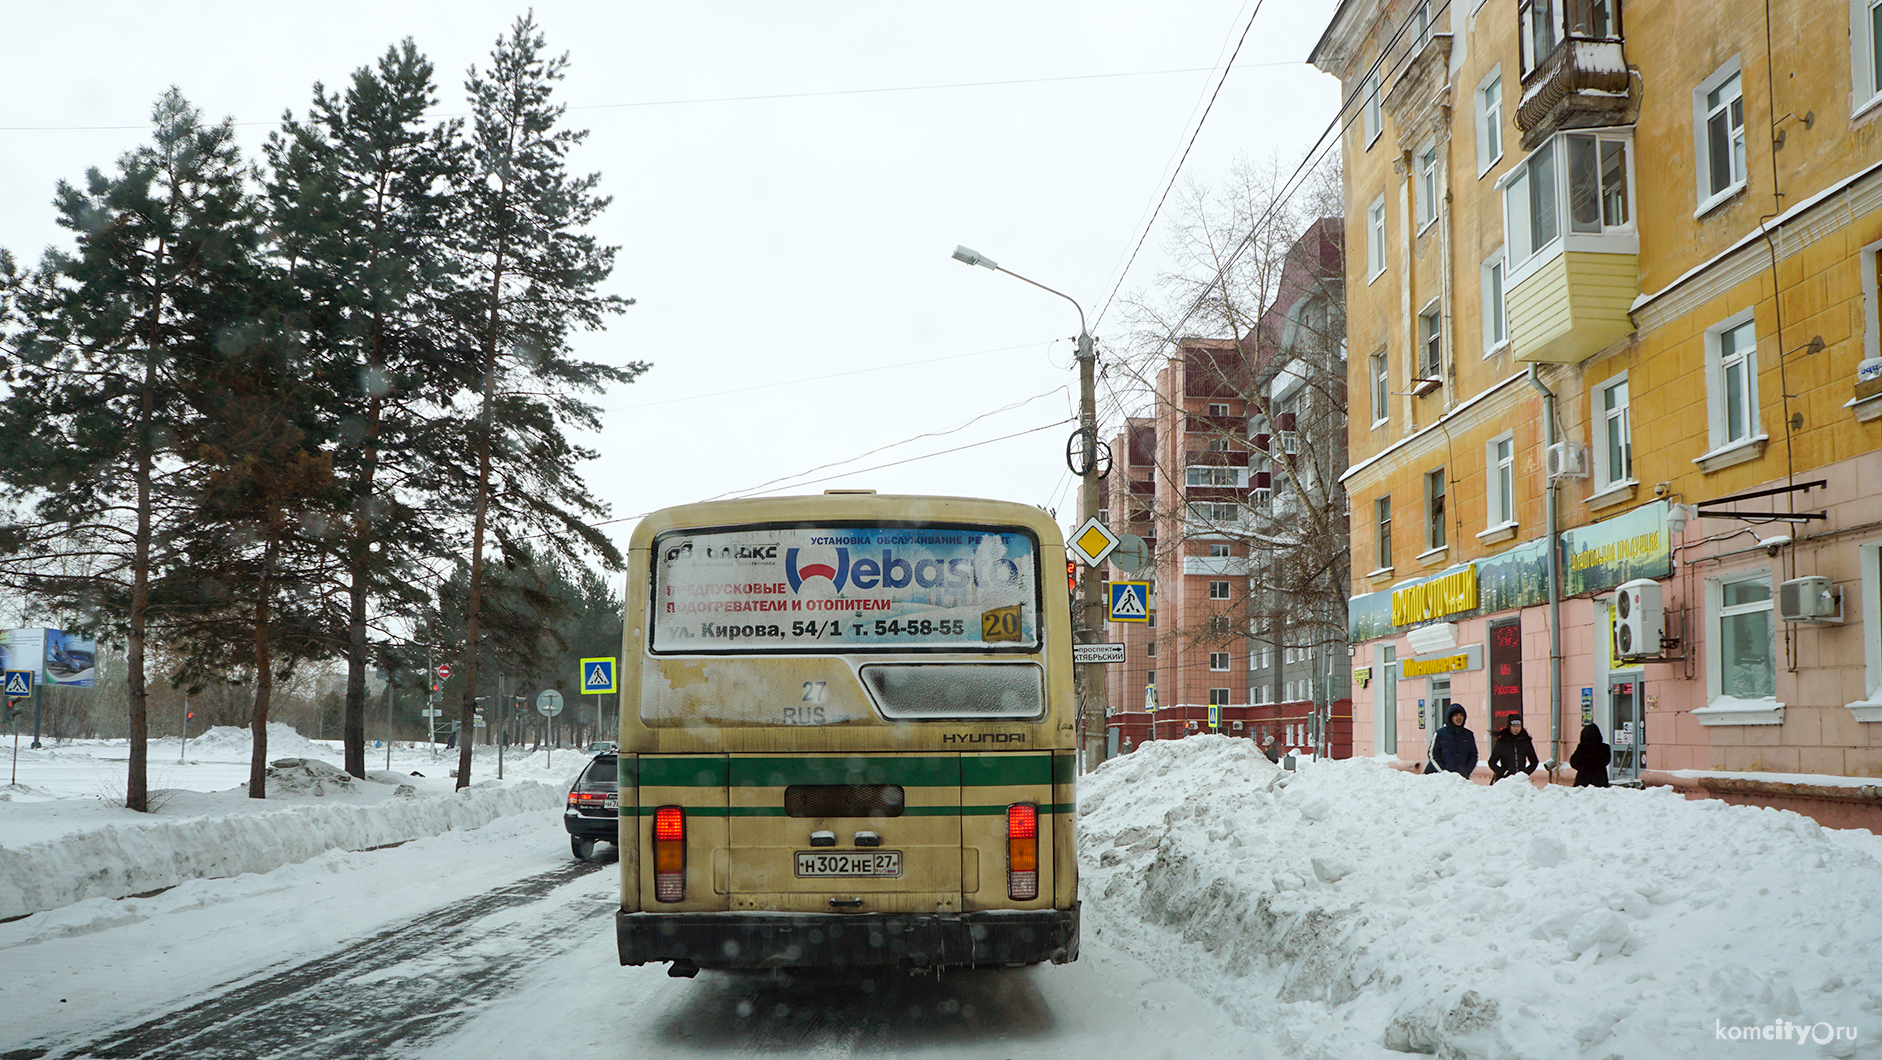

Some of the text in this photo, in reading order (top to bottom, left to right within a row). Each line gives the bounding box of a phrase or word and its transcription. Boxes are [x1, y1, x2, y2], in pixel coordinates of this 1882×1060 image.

[810, 535, 1010, 545] УСТАНОВКА ОБСЛУЖИВАНИЕ РЕТ
[1617, 530, 1659, 560] ПРОДУКЦИЯ
[1067, 562, 1075, 574] 2
[667, 583, 787, 597] ПЕДПУСКОВЫЕ
[1391, 564, 1477, 627] КРУГЛОСУТОЧНЫЙ
[792, 600, 801, 611] И
[806, 599, 892, 611] ОТОПИТЕЛИ
[668, 619, 964, 641] ул. Кирова, 54/1 т. 54-58-55
[984, 612, 1018, 637] 20
[1074, 652, 1123, 661] КТЯБРЬСКИЙ
[802, 681, 827, 702] 27
[783, 706, 826, 724] RUS
[943, 733, 1026, 743] HYUNDAI
[876, 855, 893, 868] 27
